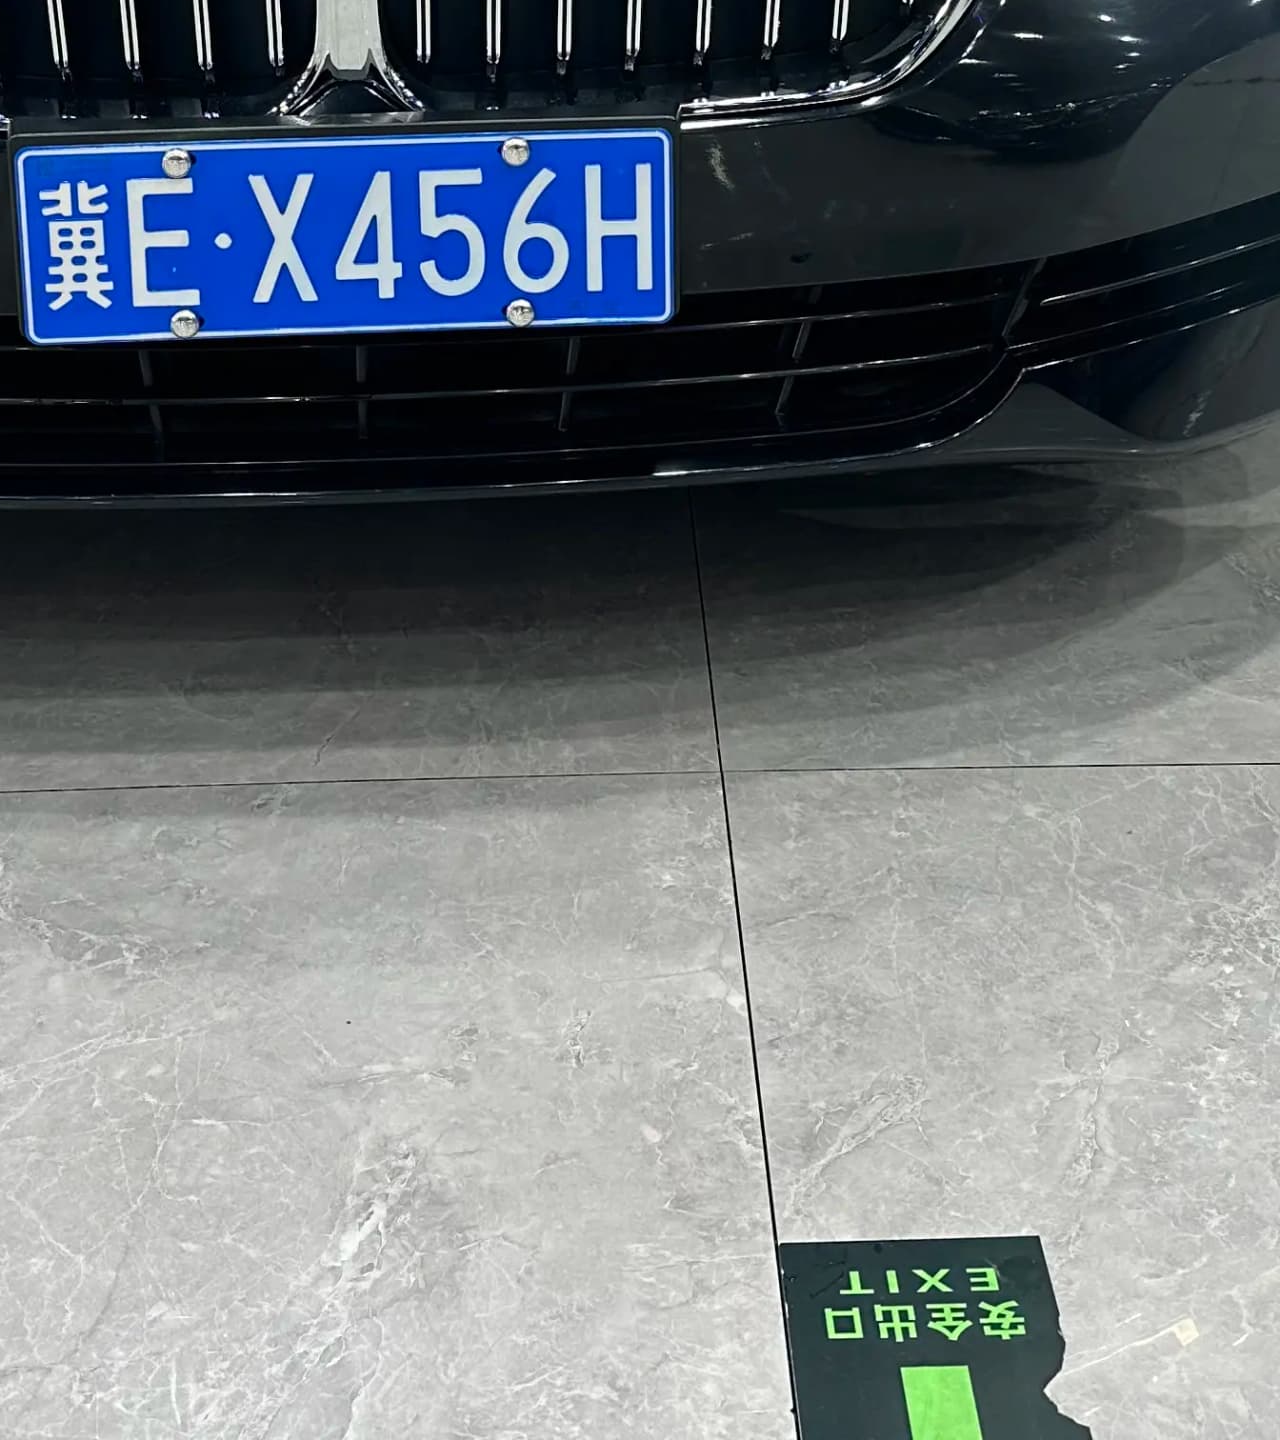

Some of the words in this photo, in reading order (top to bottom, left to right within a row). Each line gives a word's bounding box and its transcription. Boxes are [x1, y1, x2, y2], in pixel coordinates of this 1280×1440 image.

[38, 162, 654, 312] 冀E·X456H
[839, 1267, 1000, 1295] EXIT
[823, 1300, 1027, 1343] 安全出口
